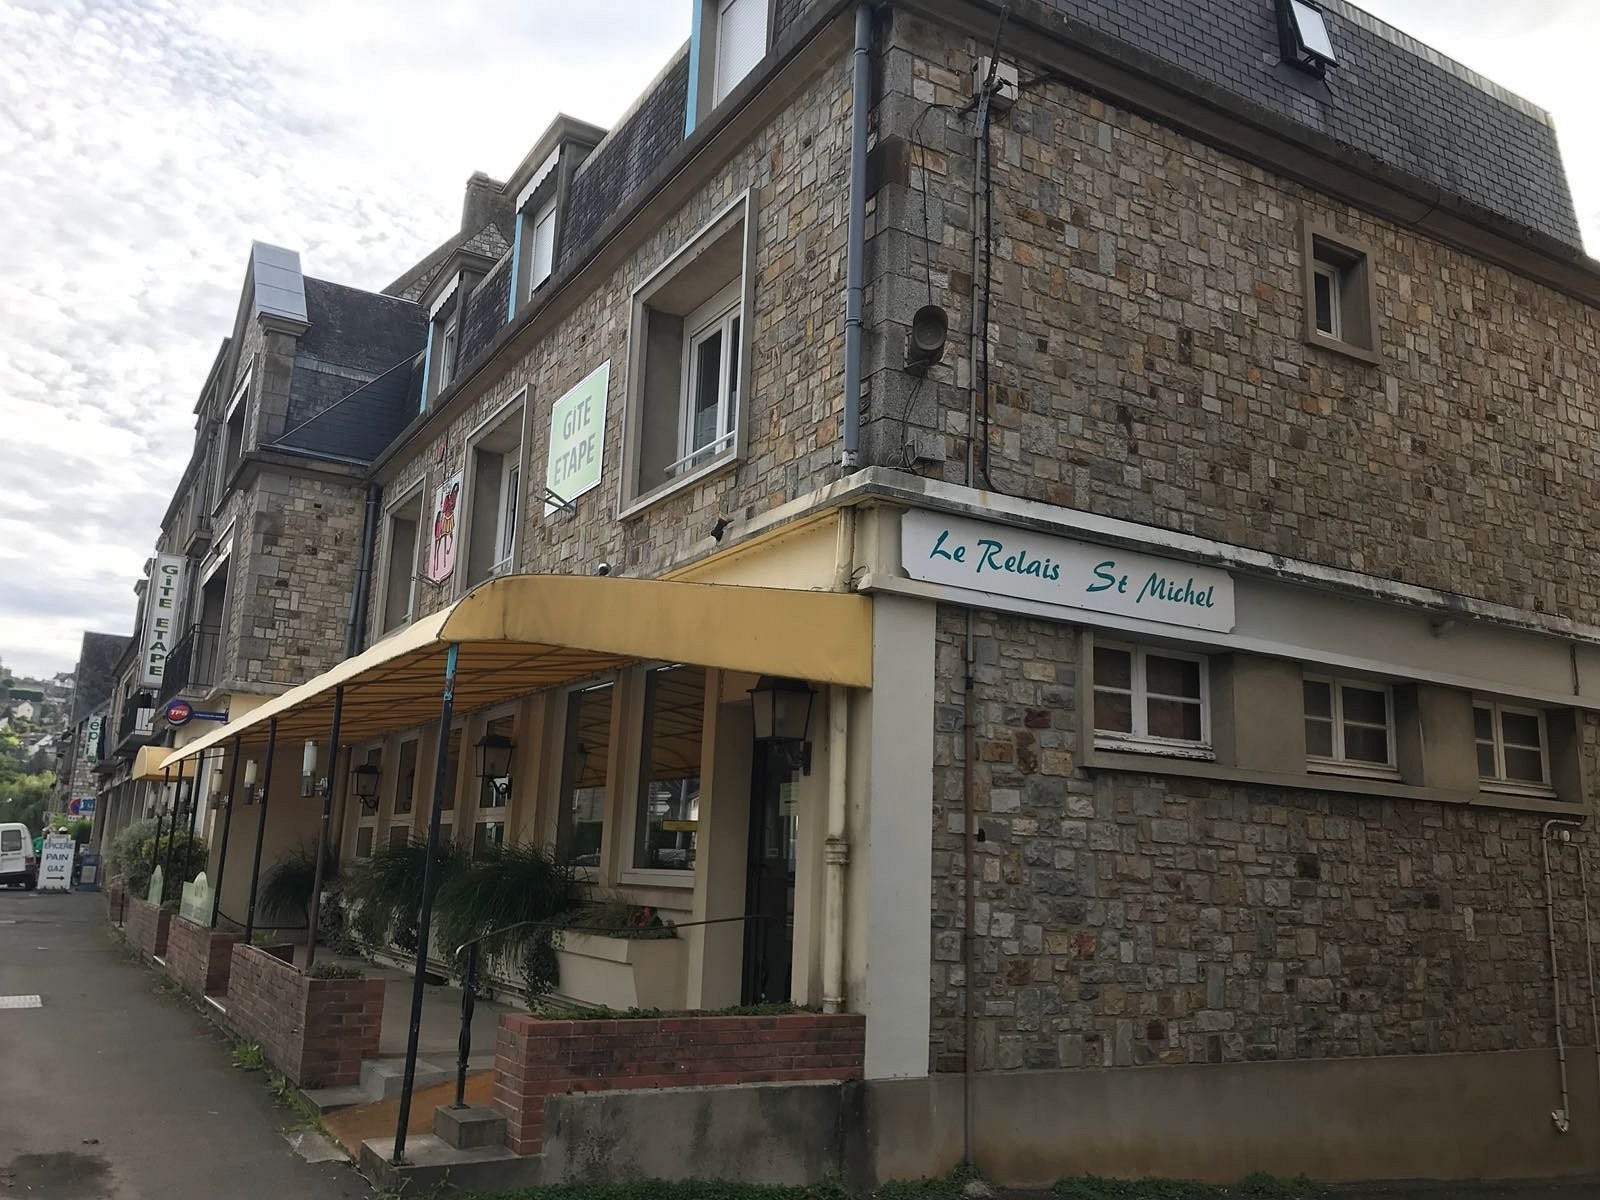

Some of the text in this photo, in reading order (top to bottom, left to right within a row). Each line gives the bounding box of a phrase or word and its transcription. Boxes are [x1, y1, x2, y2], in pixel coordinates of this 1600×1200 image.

[554, 433, 596, 486] ETAPE
[929, 529, 1215, 608] Le Relais St Michel
[149, 617, 170, 676] ETAPE
[46, 853, 69, 861] PAIN
[47, 865, 65, 873] GAZ
